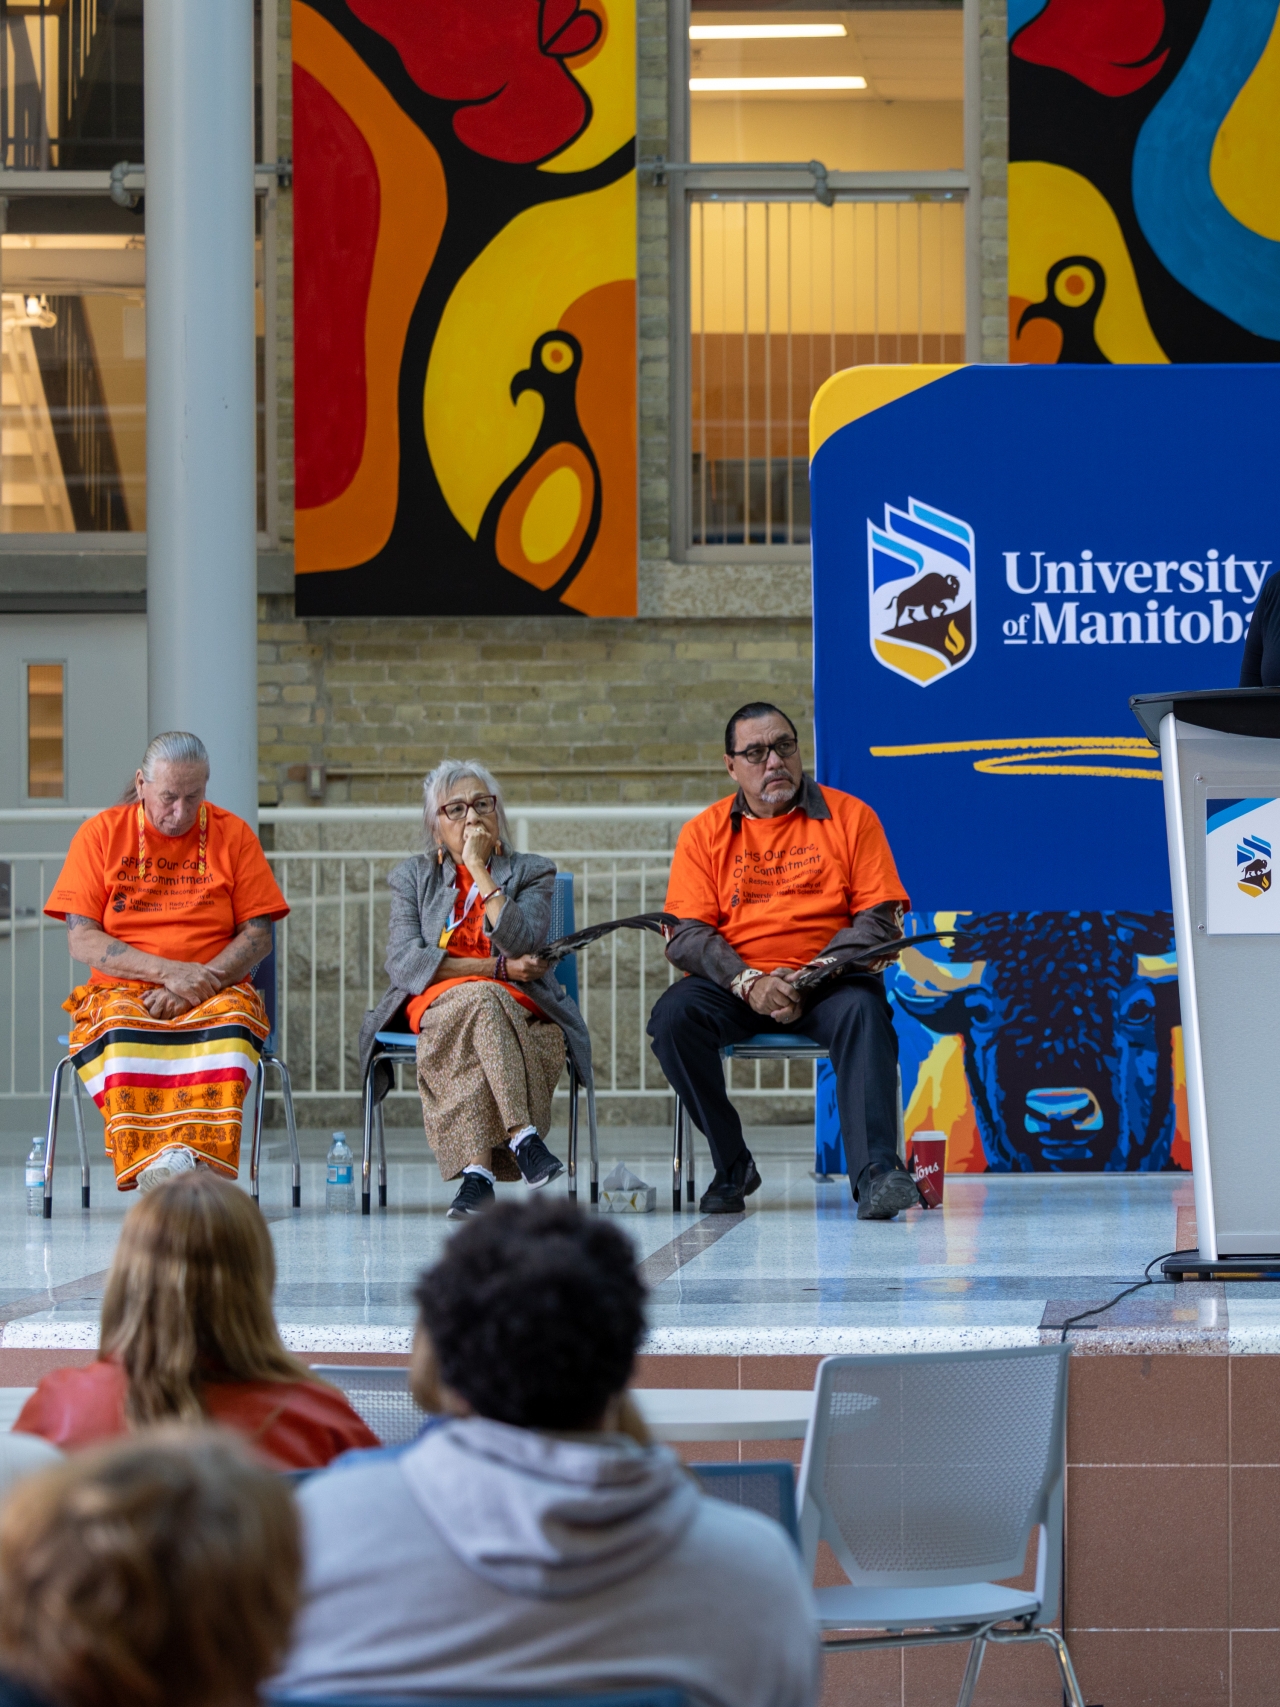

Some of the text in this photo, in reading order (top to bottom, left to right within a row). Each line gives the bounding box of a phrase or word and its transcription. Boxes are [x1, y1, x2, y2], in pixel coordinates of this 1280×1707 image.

[1002, 549, 1273, 604] University
[1002, 599, 1252, 645] of Manitob
[764, 850, 786, 862] Our
[789, 843, 819, 856] Care,
[157, 857, 179, 871] Our
[182, 859, 210, 870] Ca,
[733, 854, 822, 879] Or Commitment
[117, 870, 214, 886] Our Commitment
[915, 1161, 940, 1180] tons
